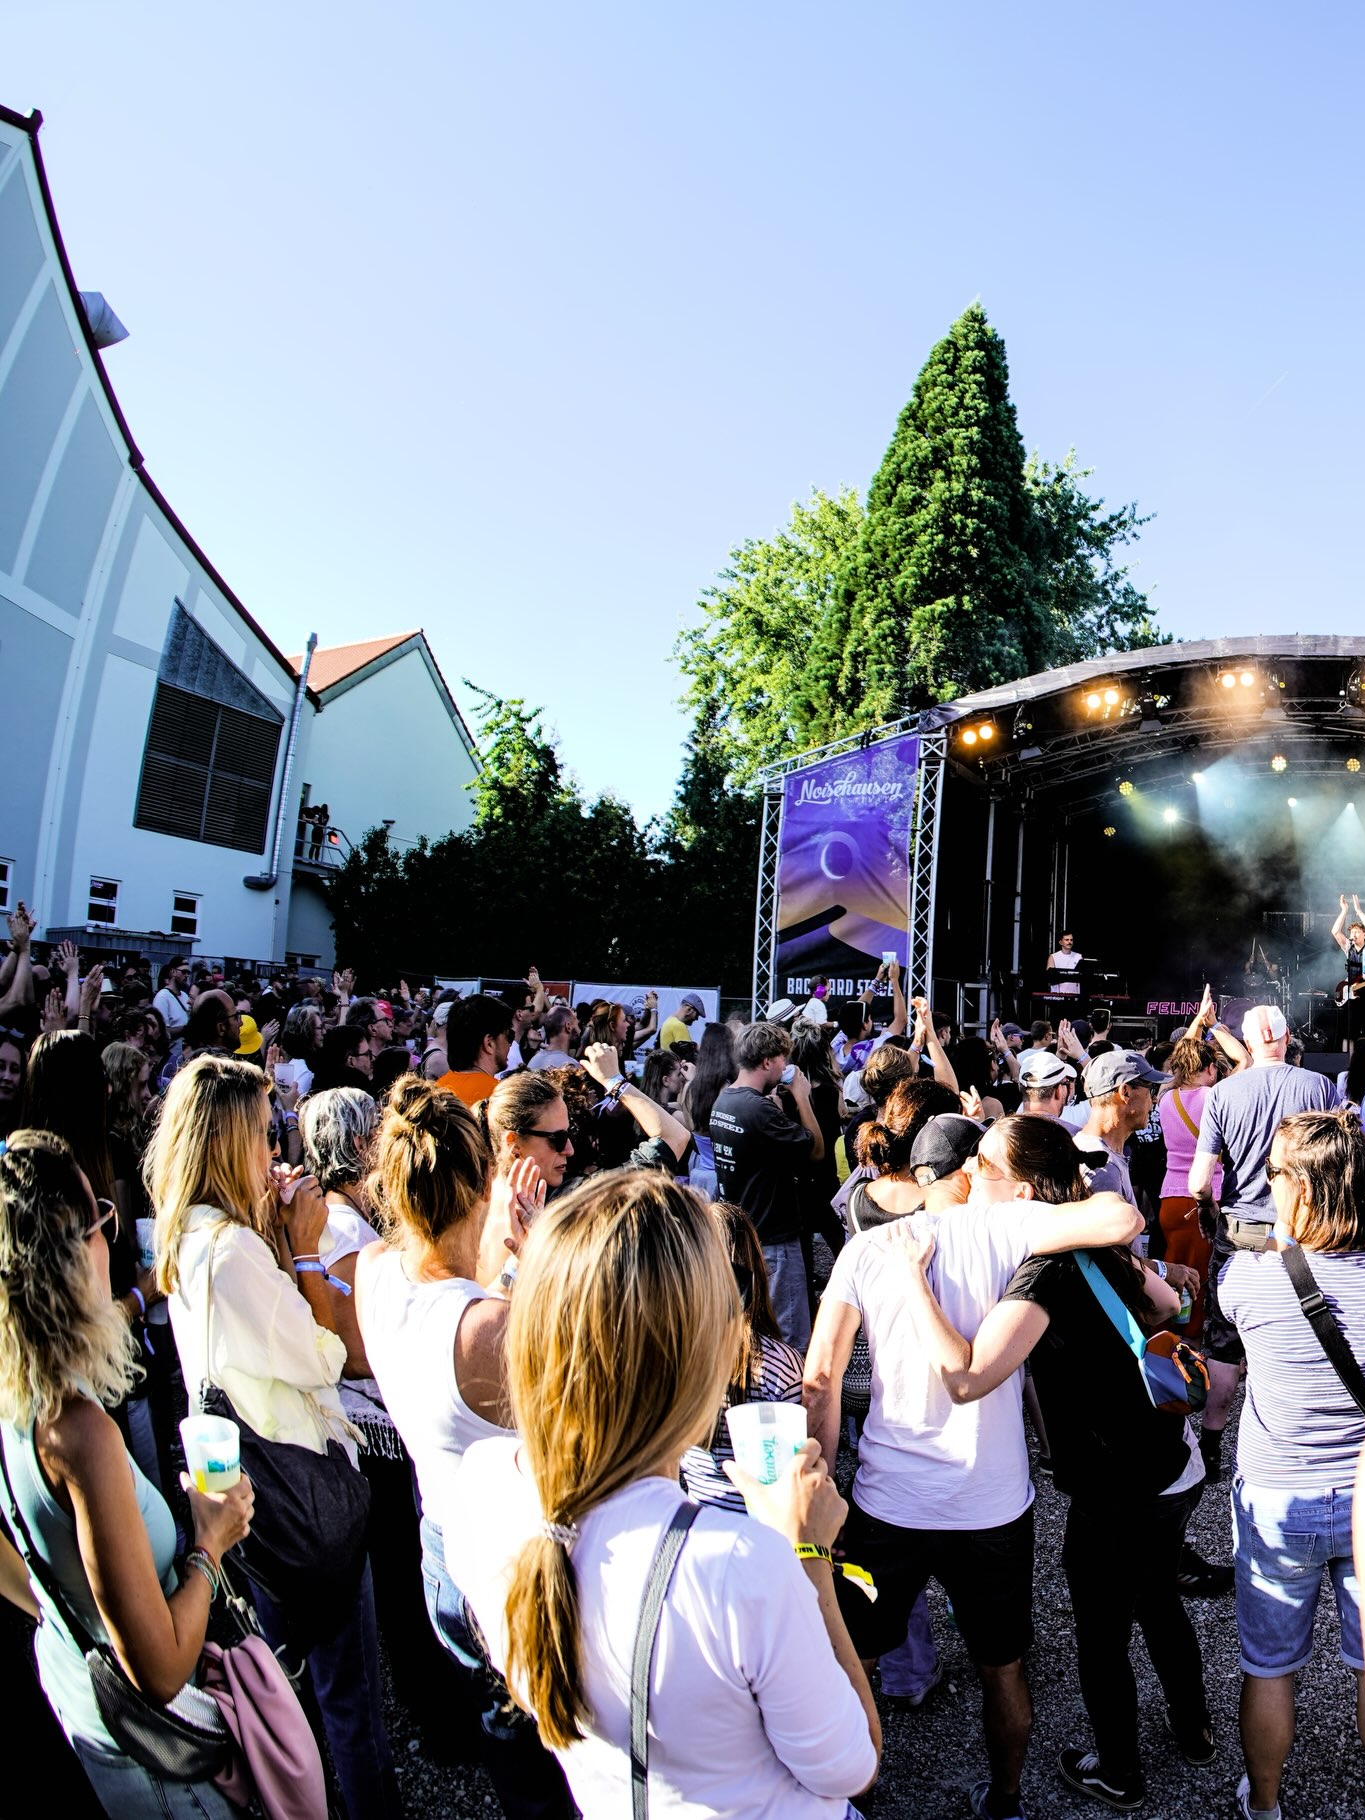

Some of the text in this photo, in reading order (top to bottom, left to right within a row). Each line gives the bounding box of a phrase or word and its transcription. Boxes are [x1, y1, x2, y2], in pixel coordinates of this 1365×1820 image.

[795, 771, 903, 807] Noisehausen
[787, 977, 854, 996] BACARD
[715, 1111, 736, 1123] NOISE
